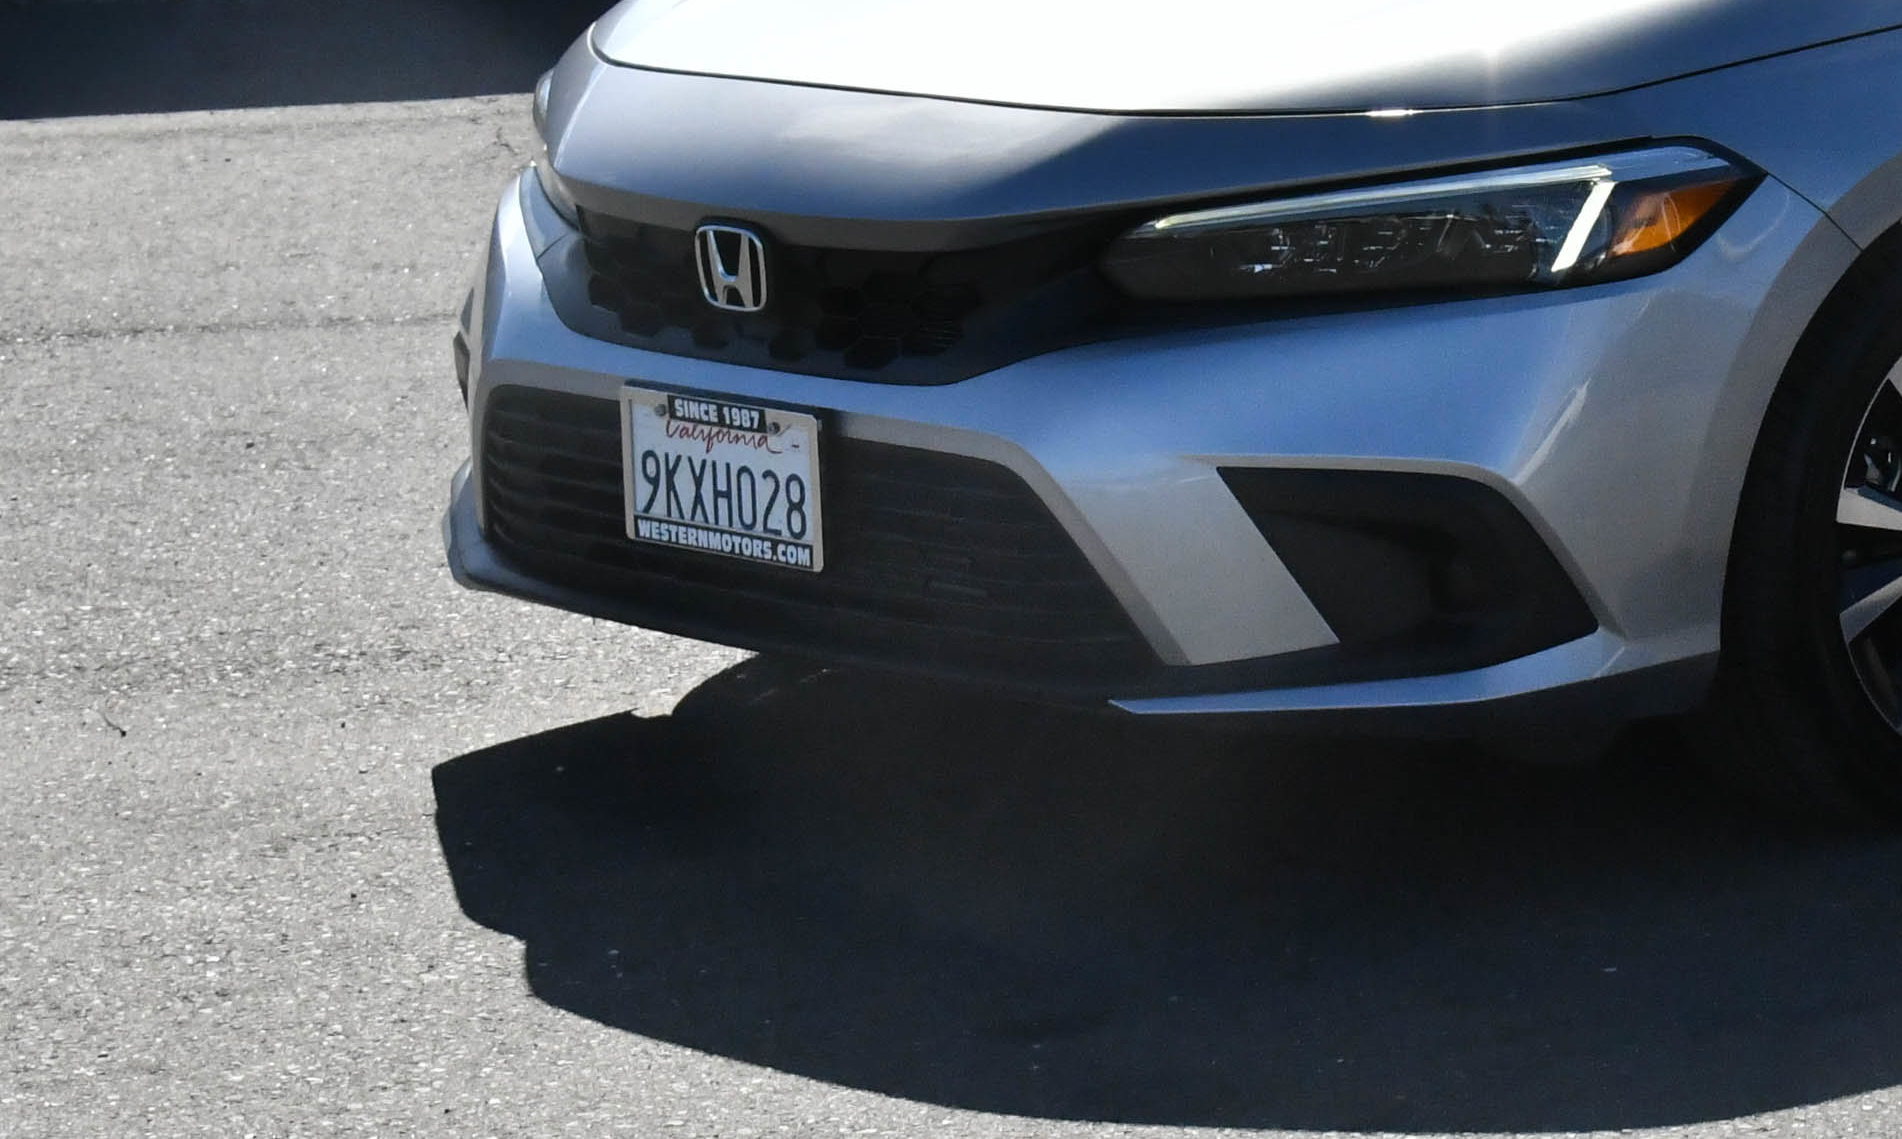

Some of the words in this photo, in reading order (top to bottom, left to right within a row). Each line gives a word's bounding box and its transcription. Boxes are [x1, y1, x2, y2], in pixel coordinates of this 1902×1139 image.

[674, 398, 719, 423] SINCE
[722, 406, 759, 429] 1987
[641, 450, 806, 539] 9KXH028
[637, 518, 812, 567] WESTERNMOTORS.COM
